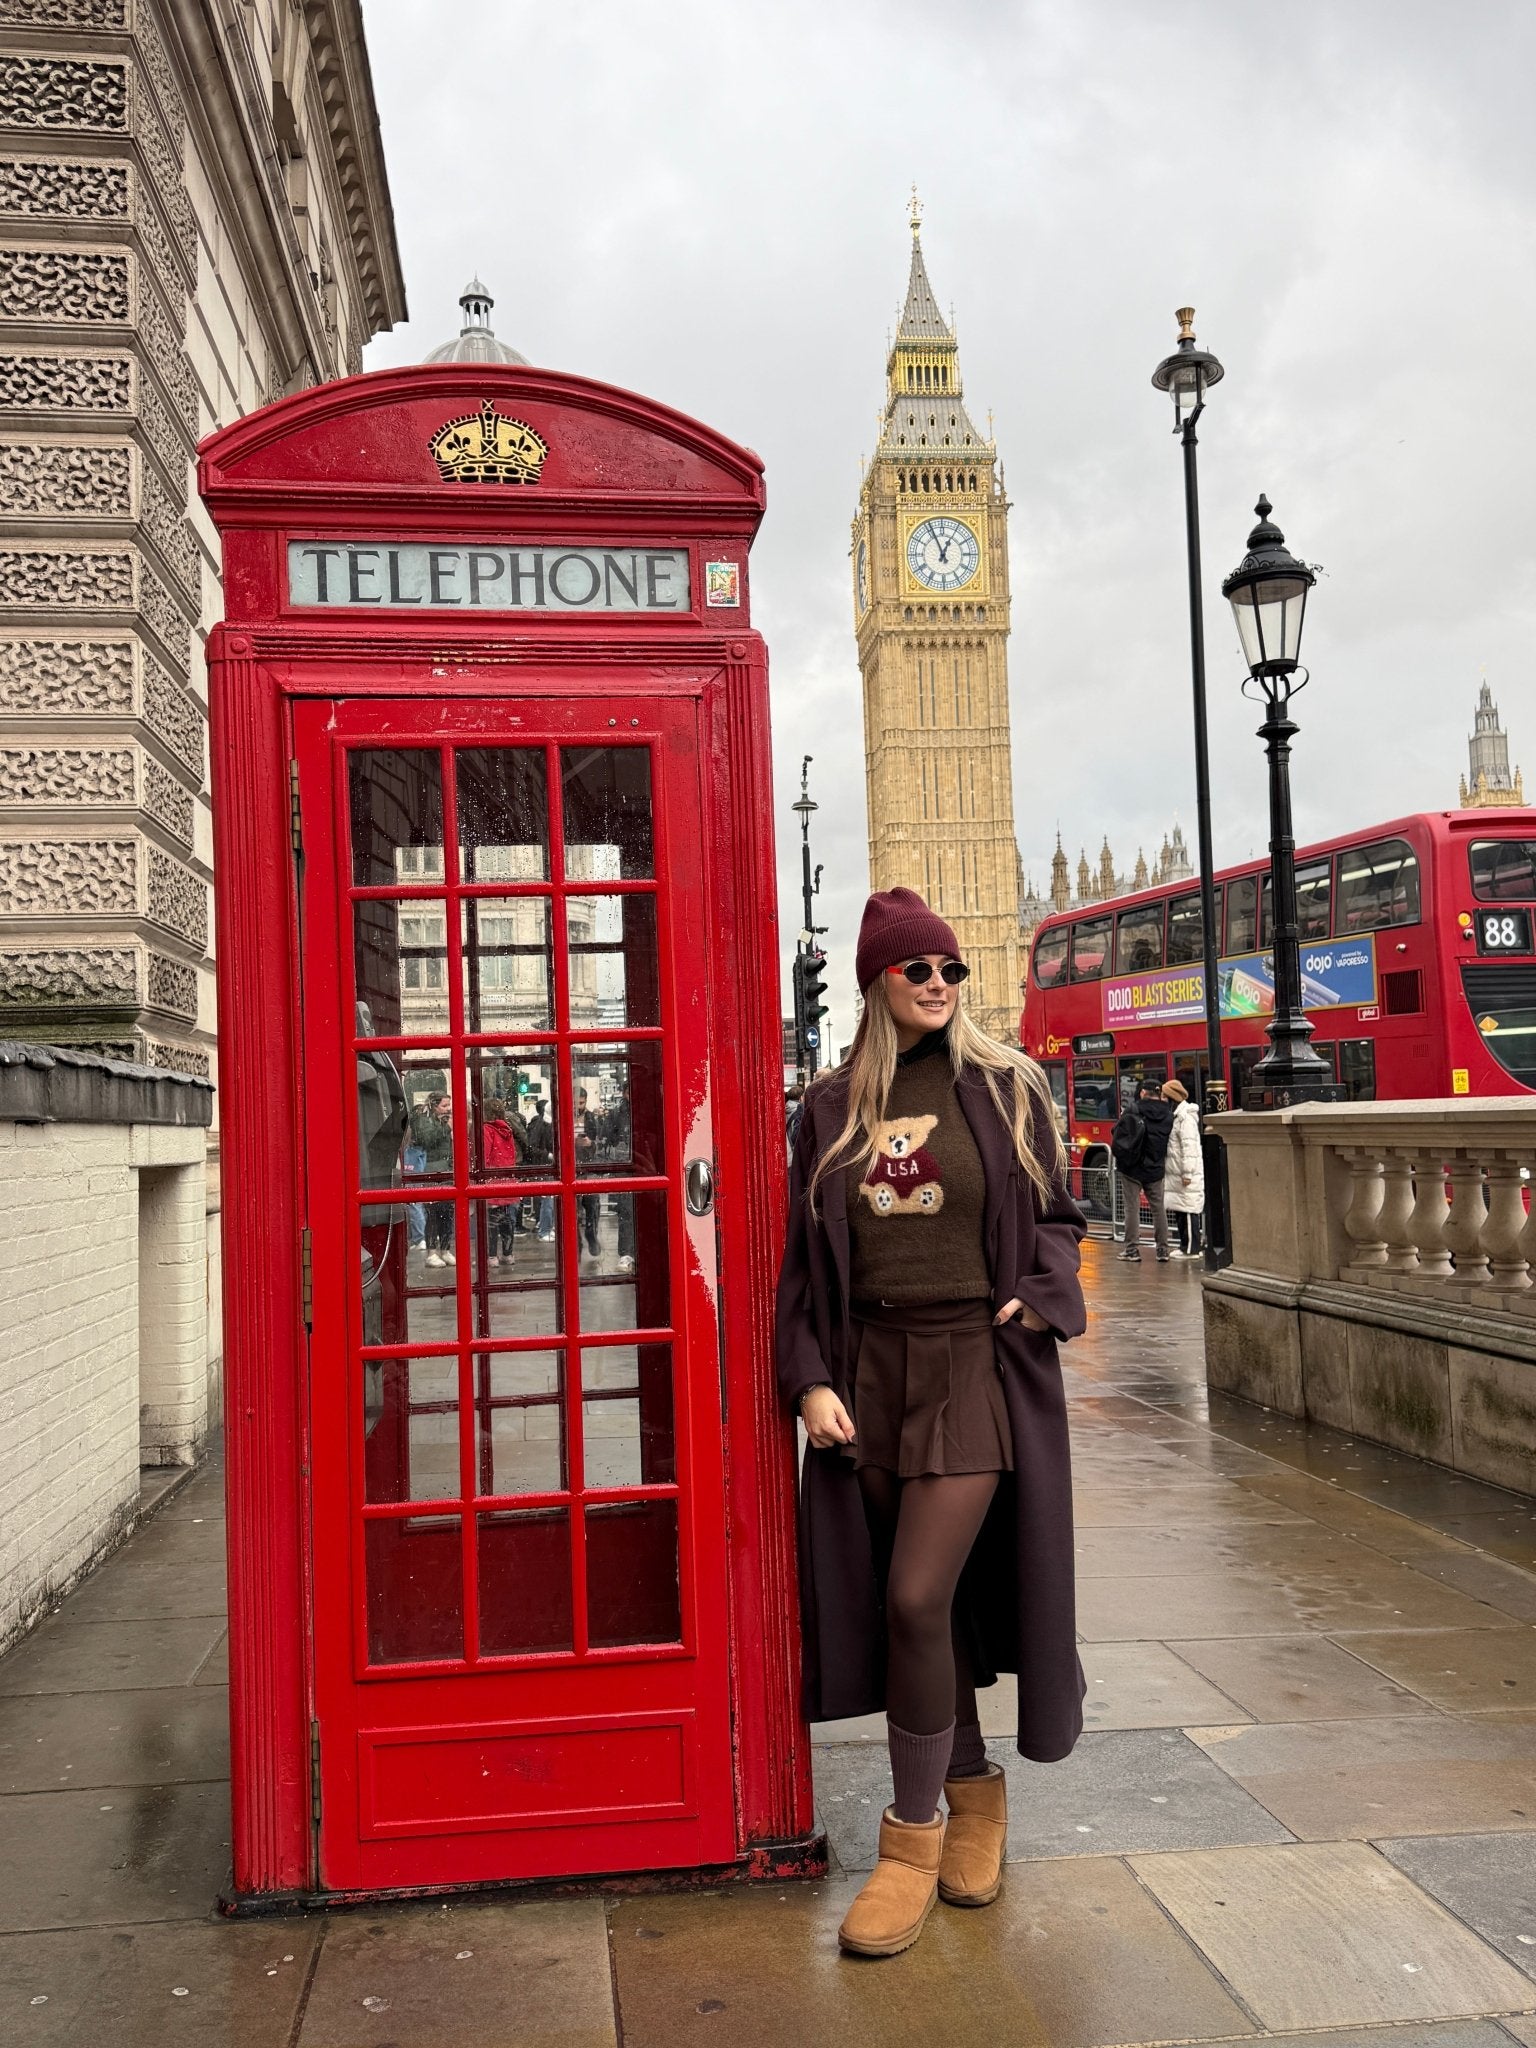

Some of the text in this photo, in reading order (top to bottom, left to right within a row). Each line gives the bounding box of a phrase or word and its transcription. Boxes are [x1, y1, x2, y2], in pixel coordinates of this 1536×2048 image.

[302, 550, 678, 607] TELEPHONE
[1485, 917, 1516, 947] 88
[1306, 954, 1332, 974] dojo
[1336, 955, 1369, 968] VAPORESSO
[1108, 976, 1204, 1012] DOJO BLAST SERIES
[1236, 981, 1261, 1004] dojo
[886, 1159, 919, 1177] USA
